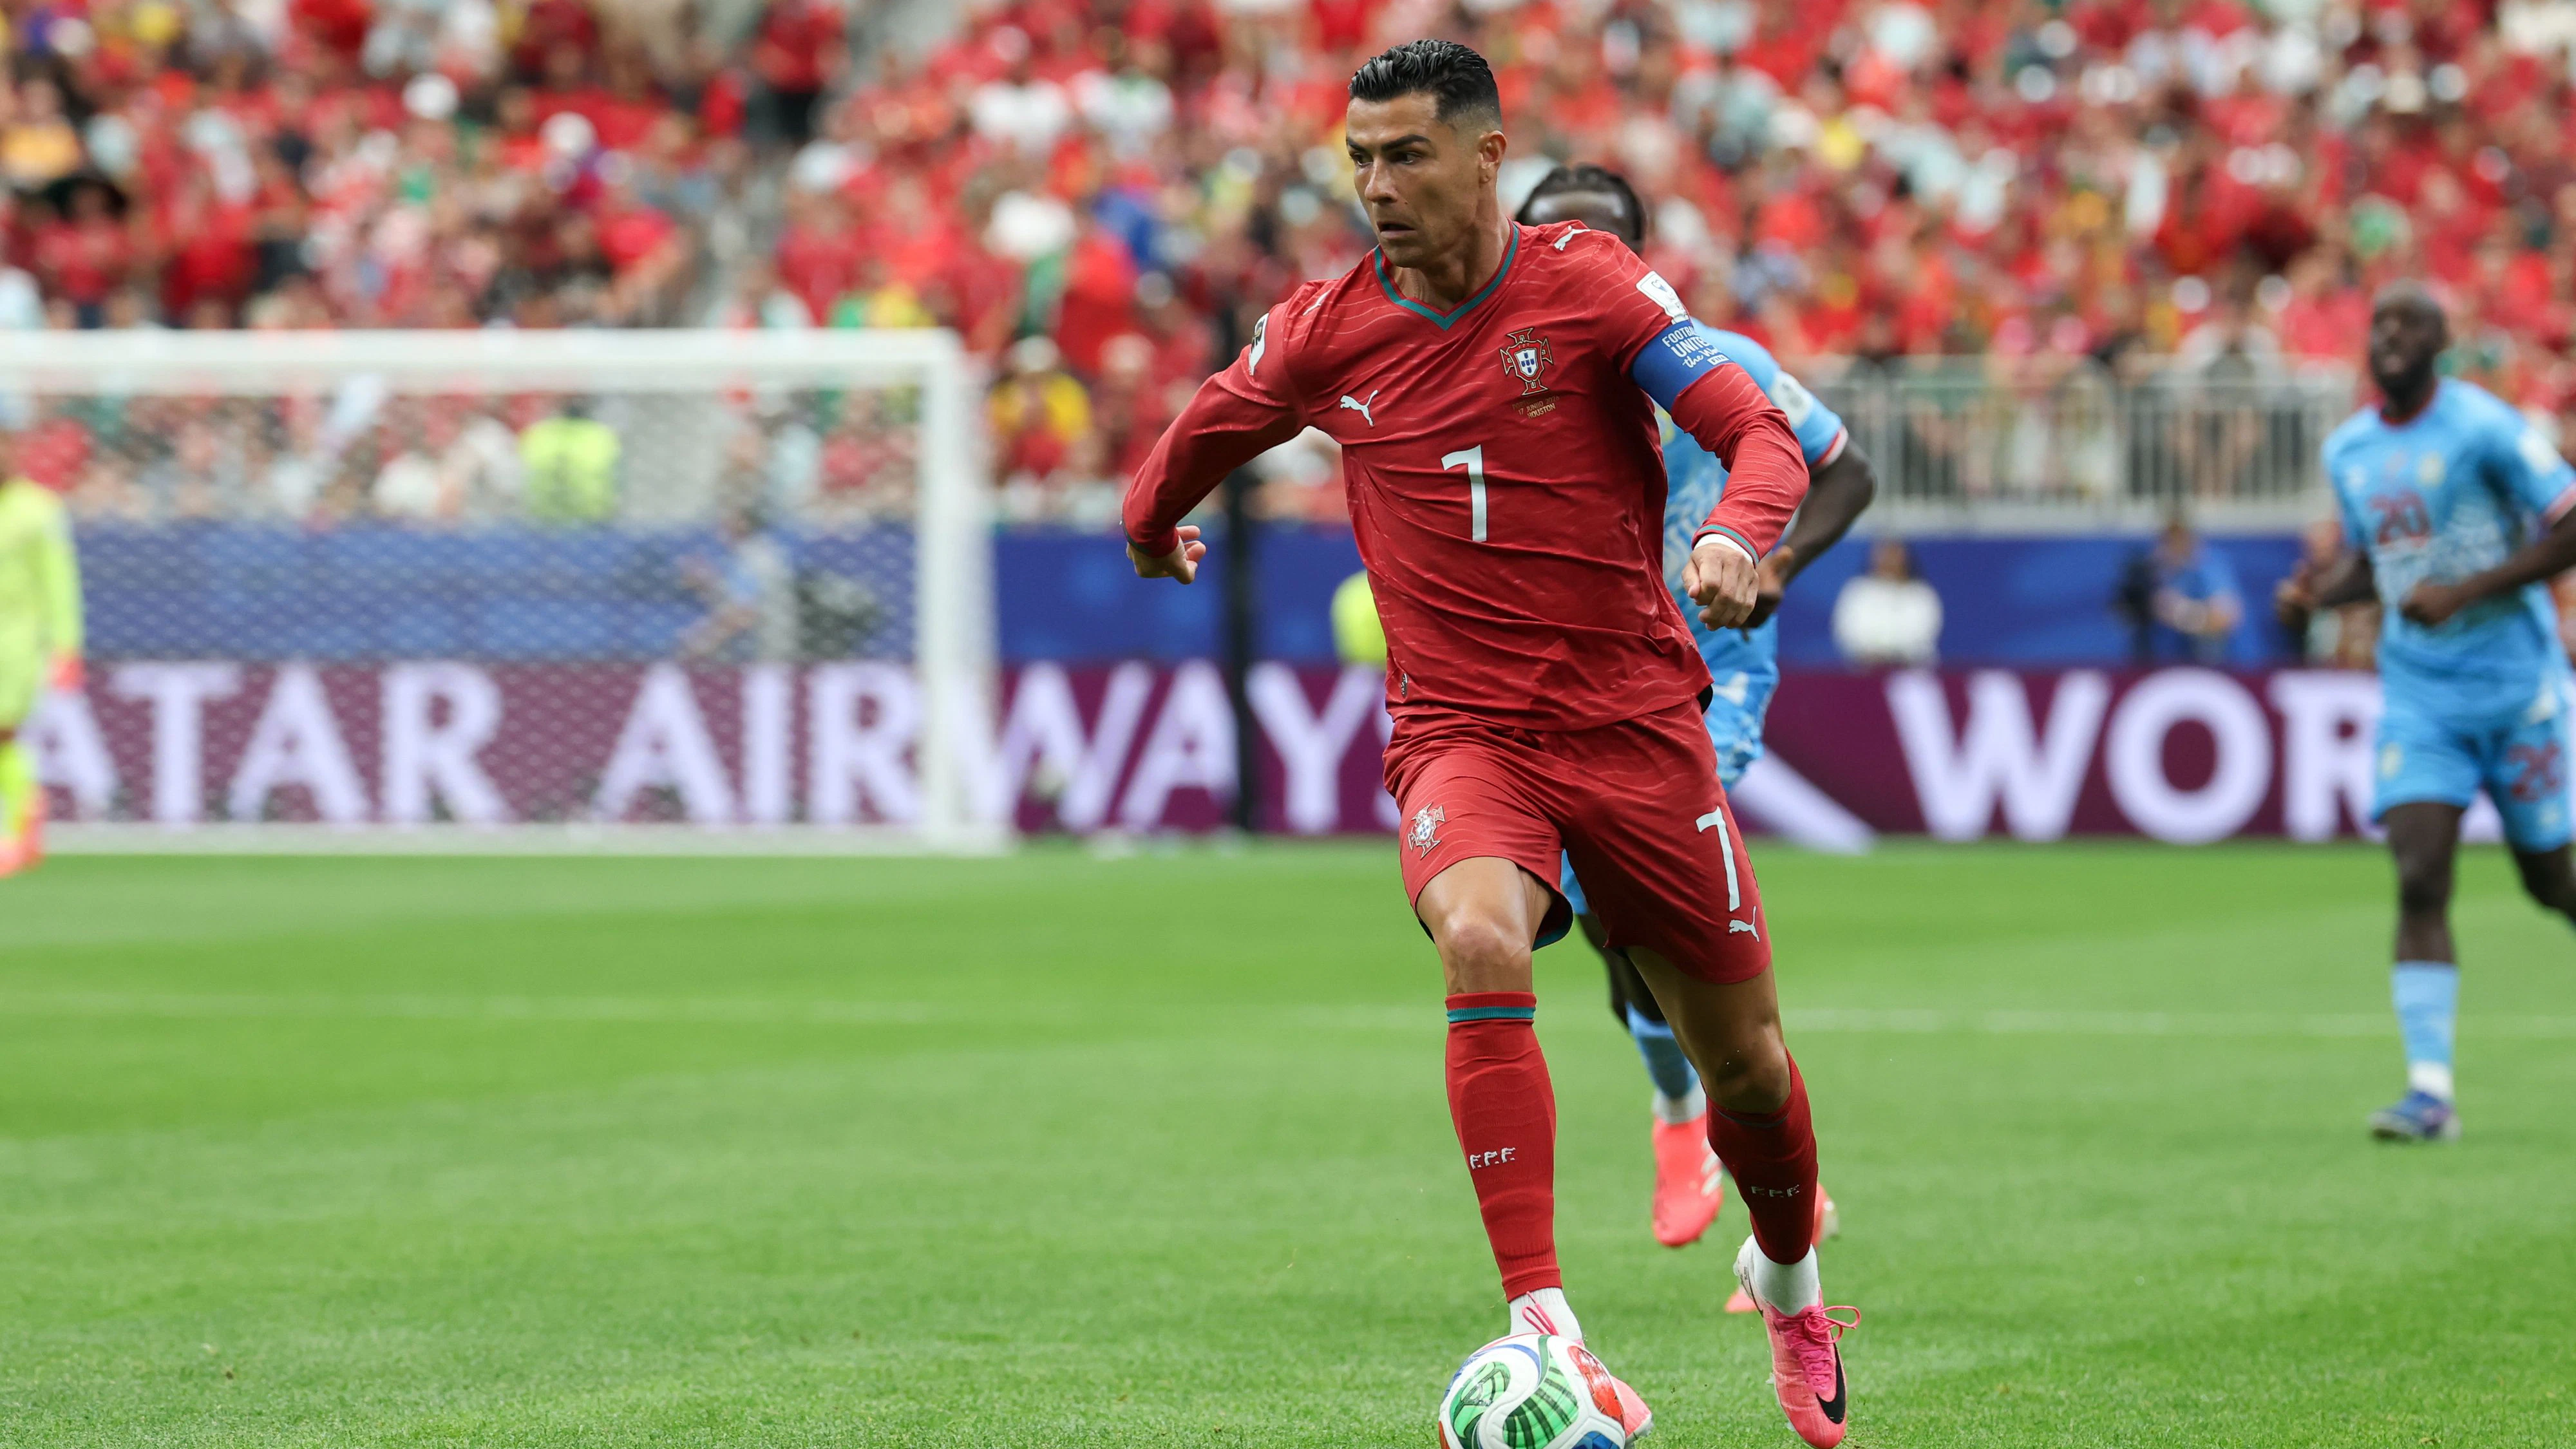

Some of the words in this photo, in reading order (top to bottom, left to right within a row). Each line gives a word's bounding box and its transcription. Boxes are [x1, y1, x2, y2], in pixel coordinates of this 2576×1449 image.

[1671, 336, 1711, 358] UNITE
[1682, 355, 1704, 368] the
[1527, 402, 1557, 419] HOUSTON
[1441, 444, 1487, 542] 7
[12, 658, 512, 829] ATAR
[589, 656, 1401, 834] AIRWAY
[1884, 665, 2576, 844] WOR
[1695, 806, 1740, 913] 7
